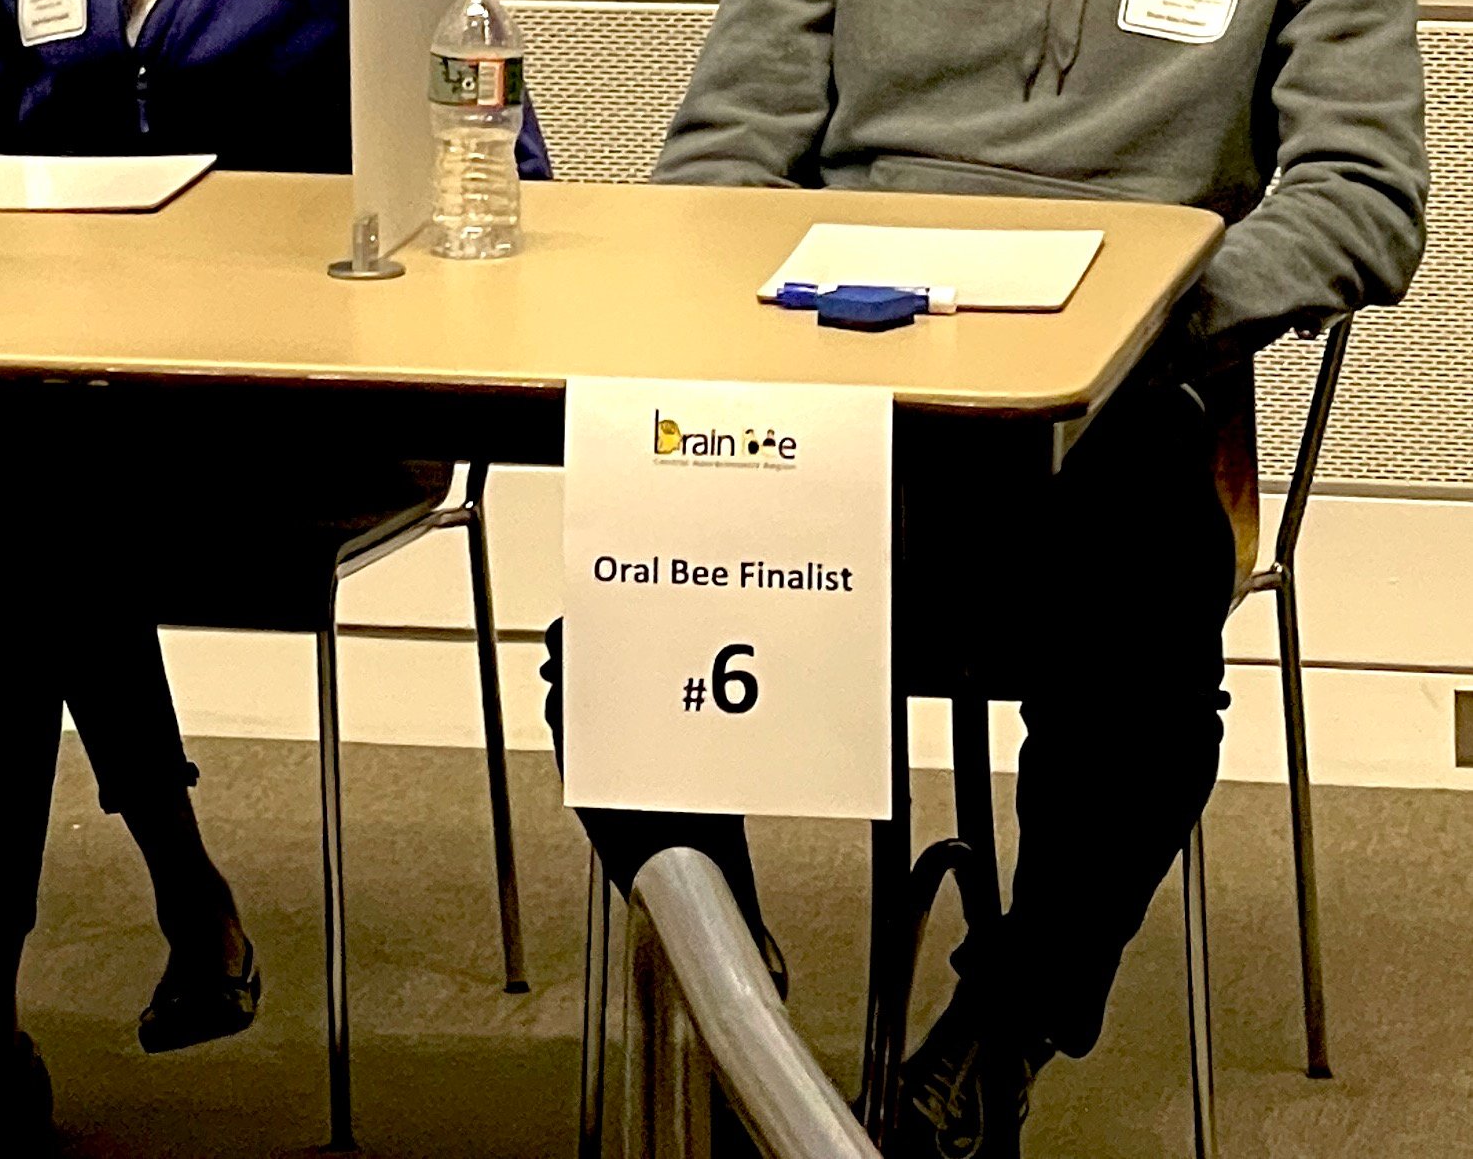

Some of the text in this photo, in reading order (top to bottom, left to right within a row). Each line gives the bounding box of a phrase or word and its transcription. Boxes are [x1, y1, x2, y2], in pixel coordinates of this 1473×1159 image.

[594, 555, 854, 592] Oral Bee Finalist
[682, 643, 760, 715] #6
